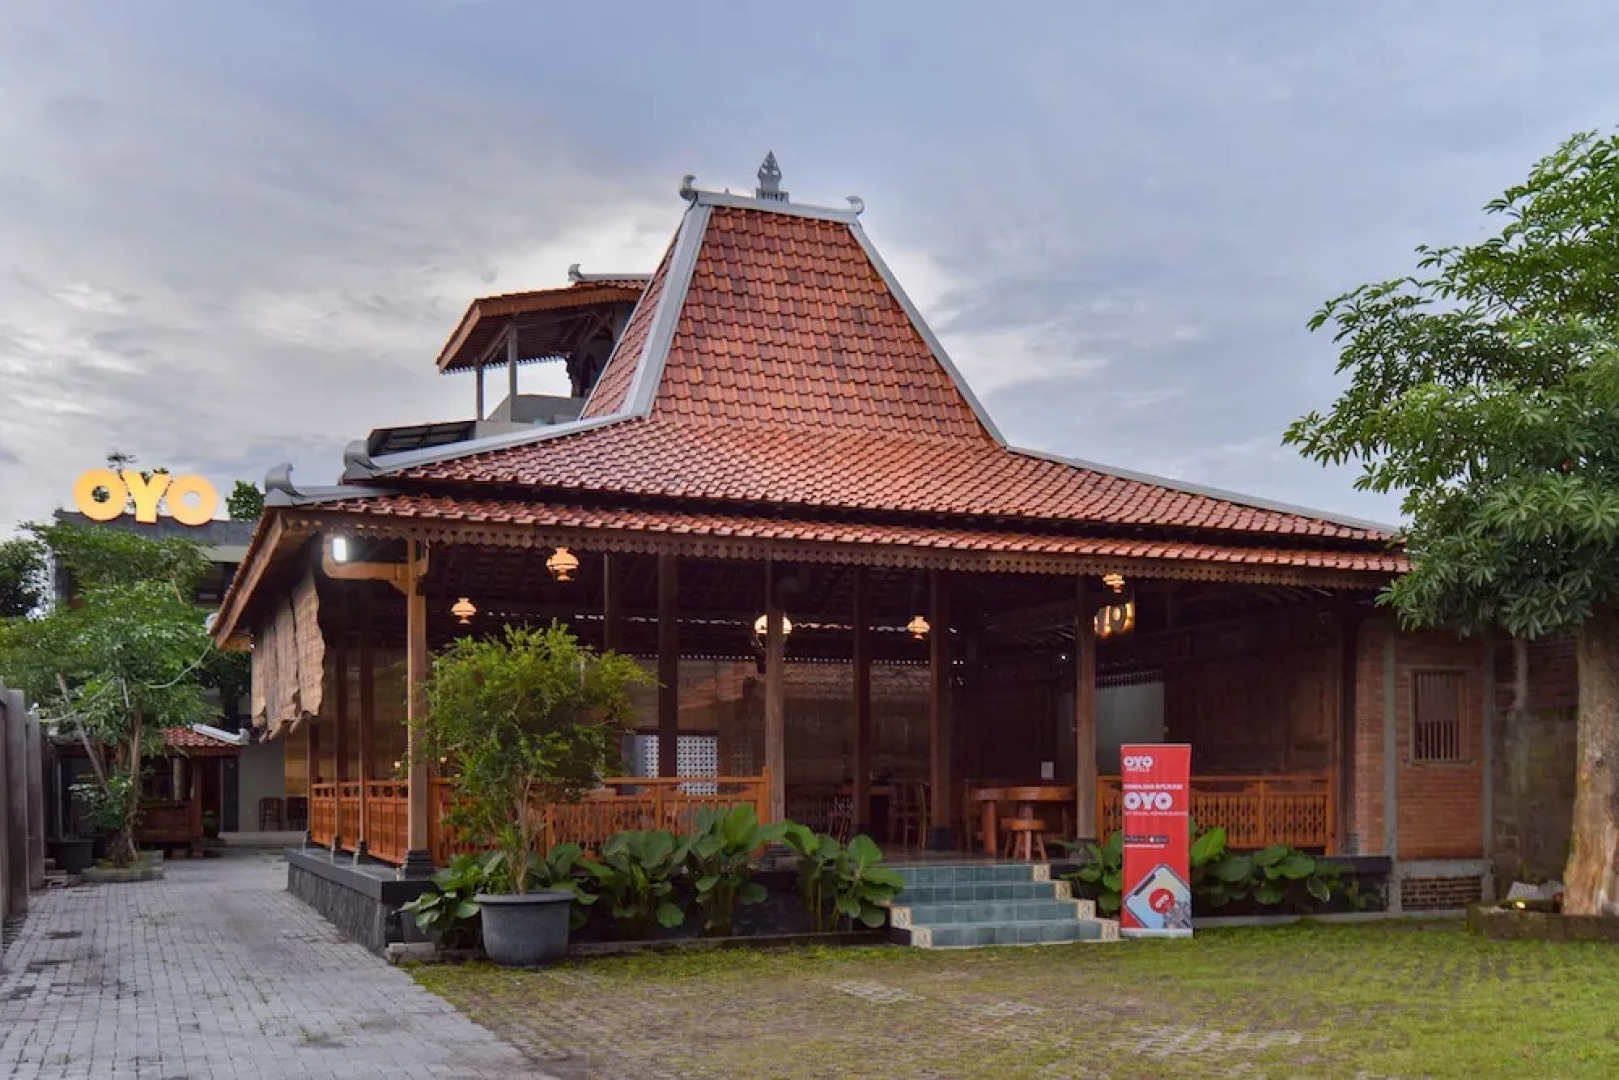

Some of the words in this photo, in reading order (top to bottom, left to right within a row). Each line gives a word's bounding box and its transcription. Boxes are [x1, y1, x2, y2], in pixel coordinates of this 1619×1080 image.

[73, 468, 219, 526] OYO
[1123, 756, 1153, 767] OYO
[1124, 791, 1173, 811] OYO
[1155, 893, 1170, 909] OYO
